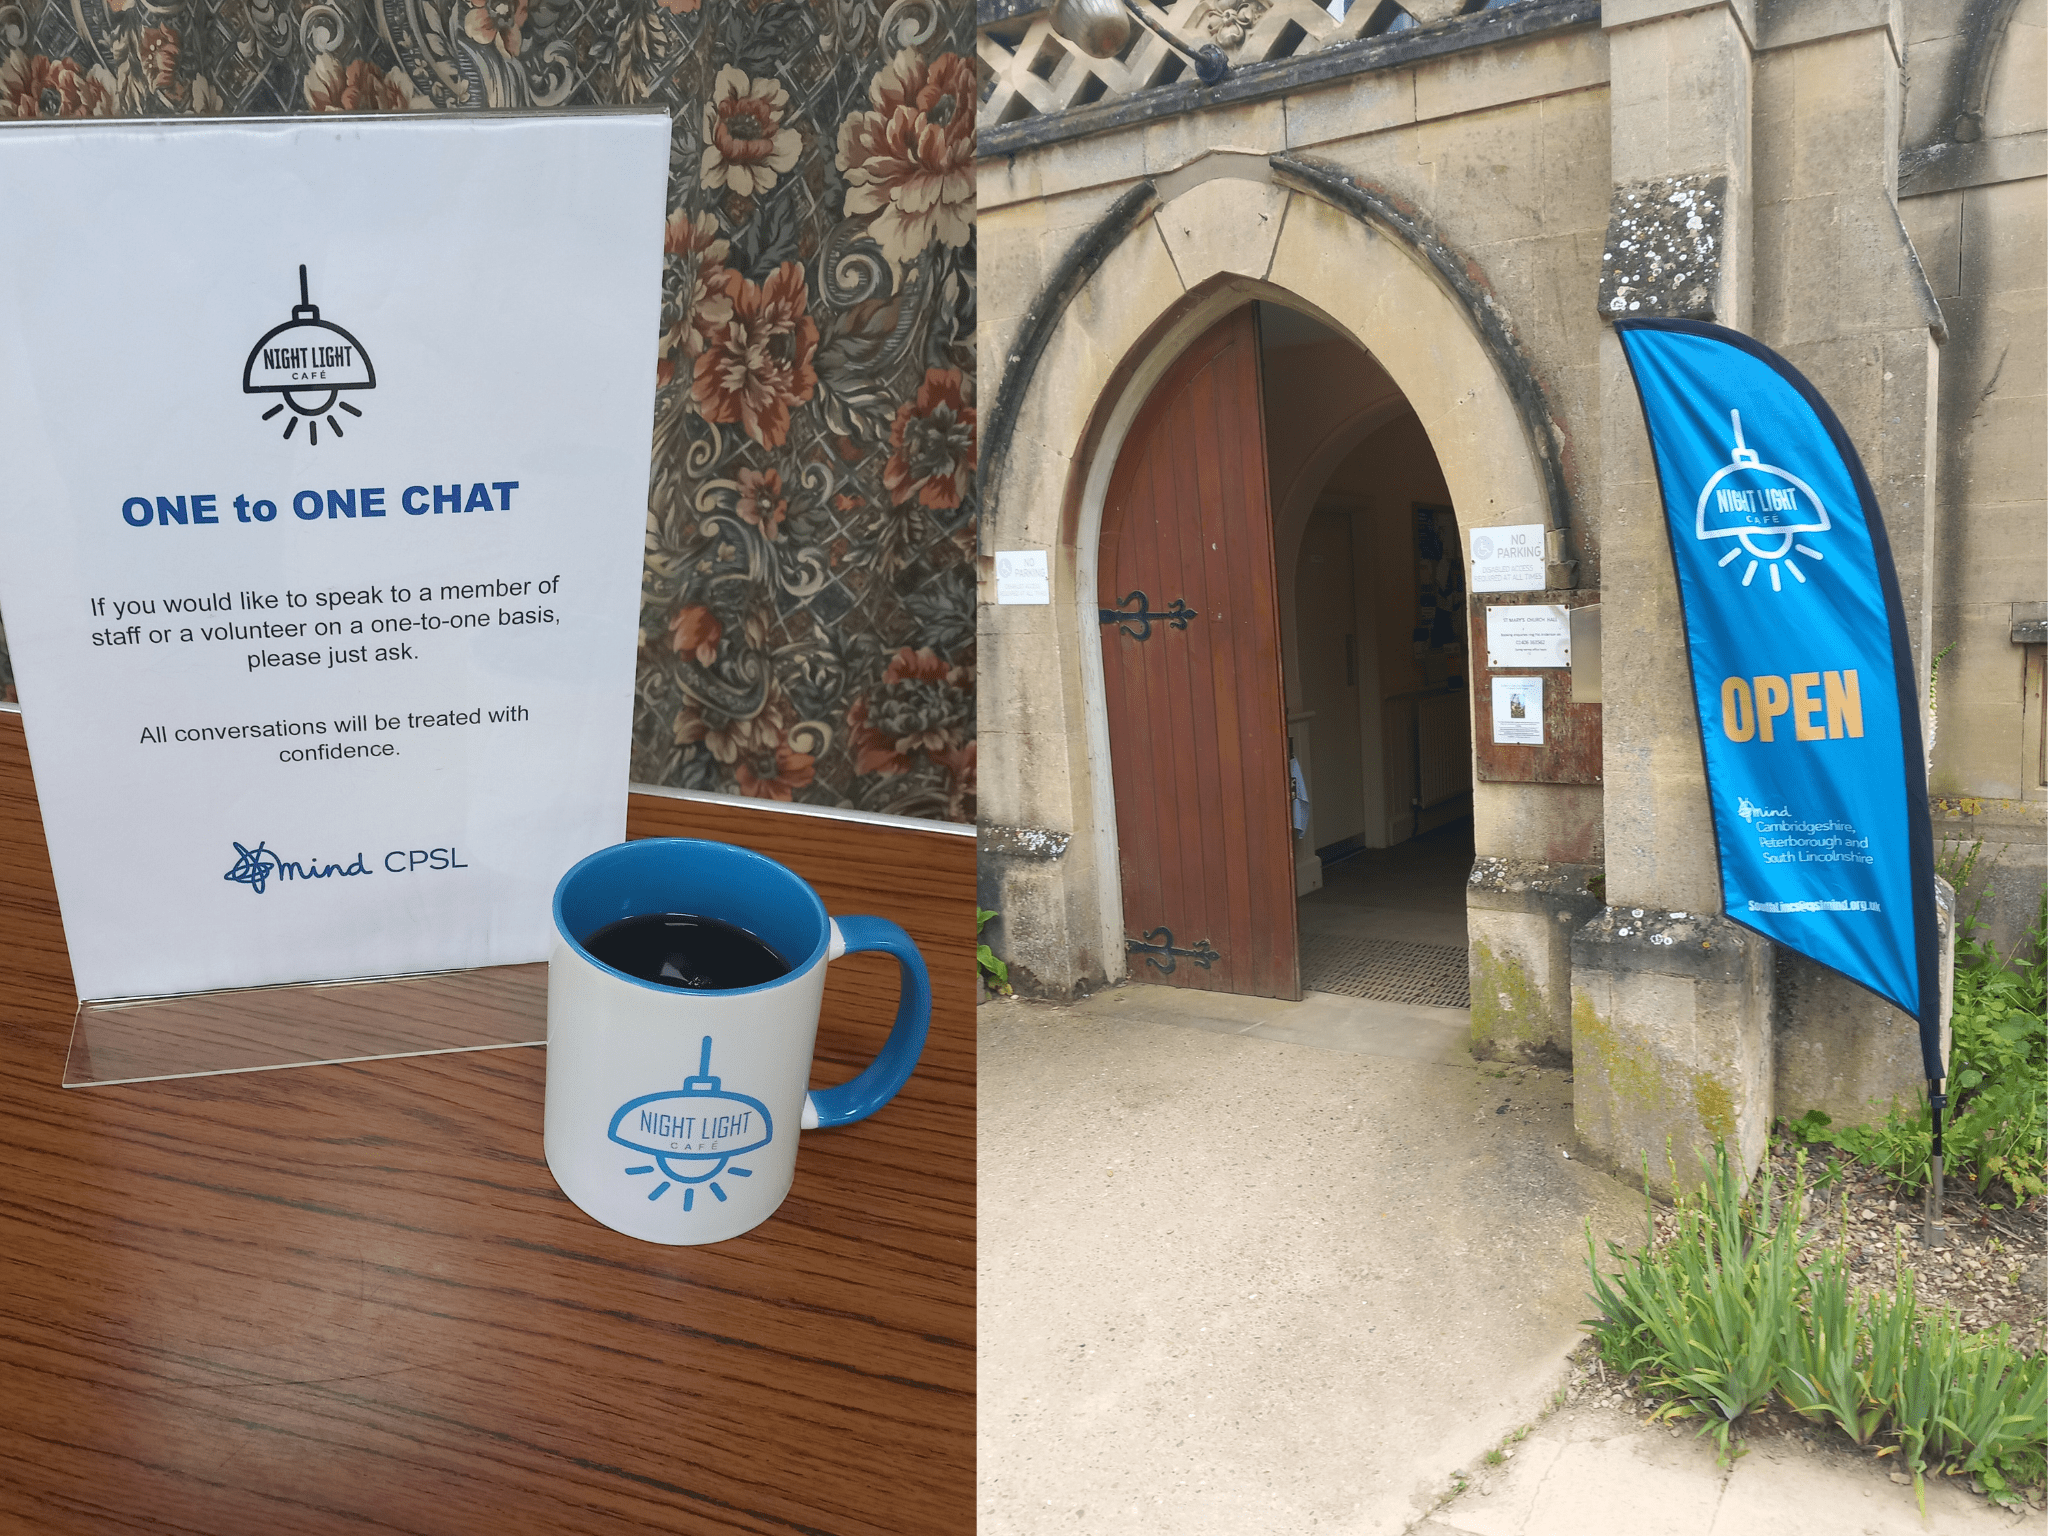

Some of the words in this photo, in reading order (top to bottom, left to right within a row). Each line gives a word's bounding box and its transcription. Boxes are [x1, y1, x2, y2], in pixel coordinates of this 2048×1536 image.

[263, 347, 309, 370] NIGHT
[311, 345, 353, 369] LIGHT
[291, 370, 327, 380] CAFÉ
[121, 495, 220, 527] ONE
[232, 494, 278, 522] to
[292, 487, 387, 520] ONE
[401, 481, 520, 515] CHAT
[1716, 488, 1757, 513] NIGHT
[1757, 487, 1798, 512] LIGHT
[1511, 533, 1526, 545] NO
[1497, 546, 1541, 558] PARKING
[1482, 565, 1510, 573] DISABLED
[91, 597, 106, 616] If
[114, 600, 157, 620] you
[163, 592, 232, 613] would
[241, 591, 279, 609] like
[286, 590, 308, 608] to
[315, 586, 384, 611] speak
[390, 585, 412, 603] to
[420, 587, 433, 601] a
[440, 578, 532, 601] member
[538, 574, 561, 594] of
[91, 626, 142, 646] staff
[149, 628, 172, 644] or
[180, 628, 194, 643] a
[201, 621, 308, 642] volunteer
[315, 621, 342, 637] on
[350, 620, 364, 634] a
[370, 613, 491, 634] one-to-one
[498, 606, 561, 626] basis,
[247, 650, 322, 673] please
[328, 646, 369, 668] just
[374, 642, 420, 662] ask.
[1721, 669, 1864, 743] OPEN
[140, 725, 168, 744] All
[174, 719, 327, 742] conversations
[334, 715, 368, 734] will
[375, 713, 401, 731] be
[407, 708, 481, 729] treated
[488, 705, 530, 724] with
[279, 742, 401, 763] confidence.
[1753, 805, 1792, 818] mind
[1756, 819, 1856, 835] Cambridgeshire,
[1759, 835, 1842, 849] Peterborough
[1845, 836, 1869, 849] and
[278, 853, 373, 881] mind
[384, 847, 468, 873] CPSL
[1762, 850, 1796, 864] South
[1798, 850, 1874, 864] Lincolnshire
[640, 1109, 696, 1139] NIGHT
[701, 1111, 752, 1139] LIGHT
[670, 1140, 719, 1151] CAFÉ
